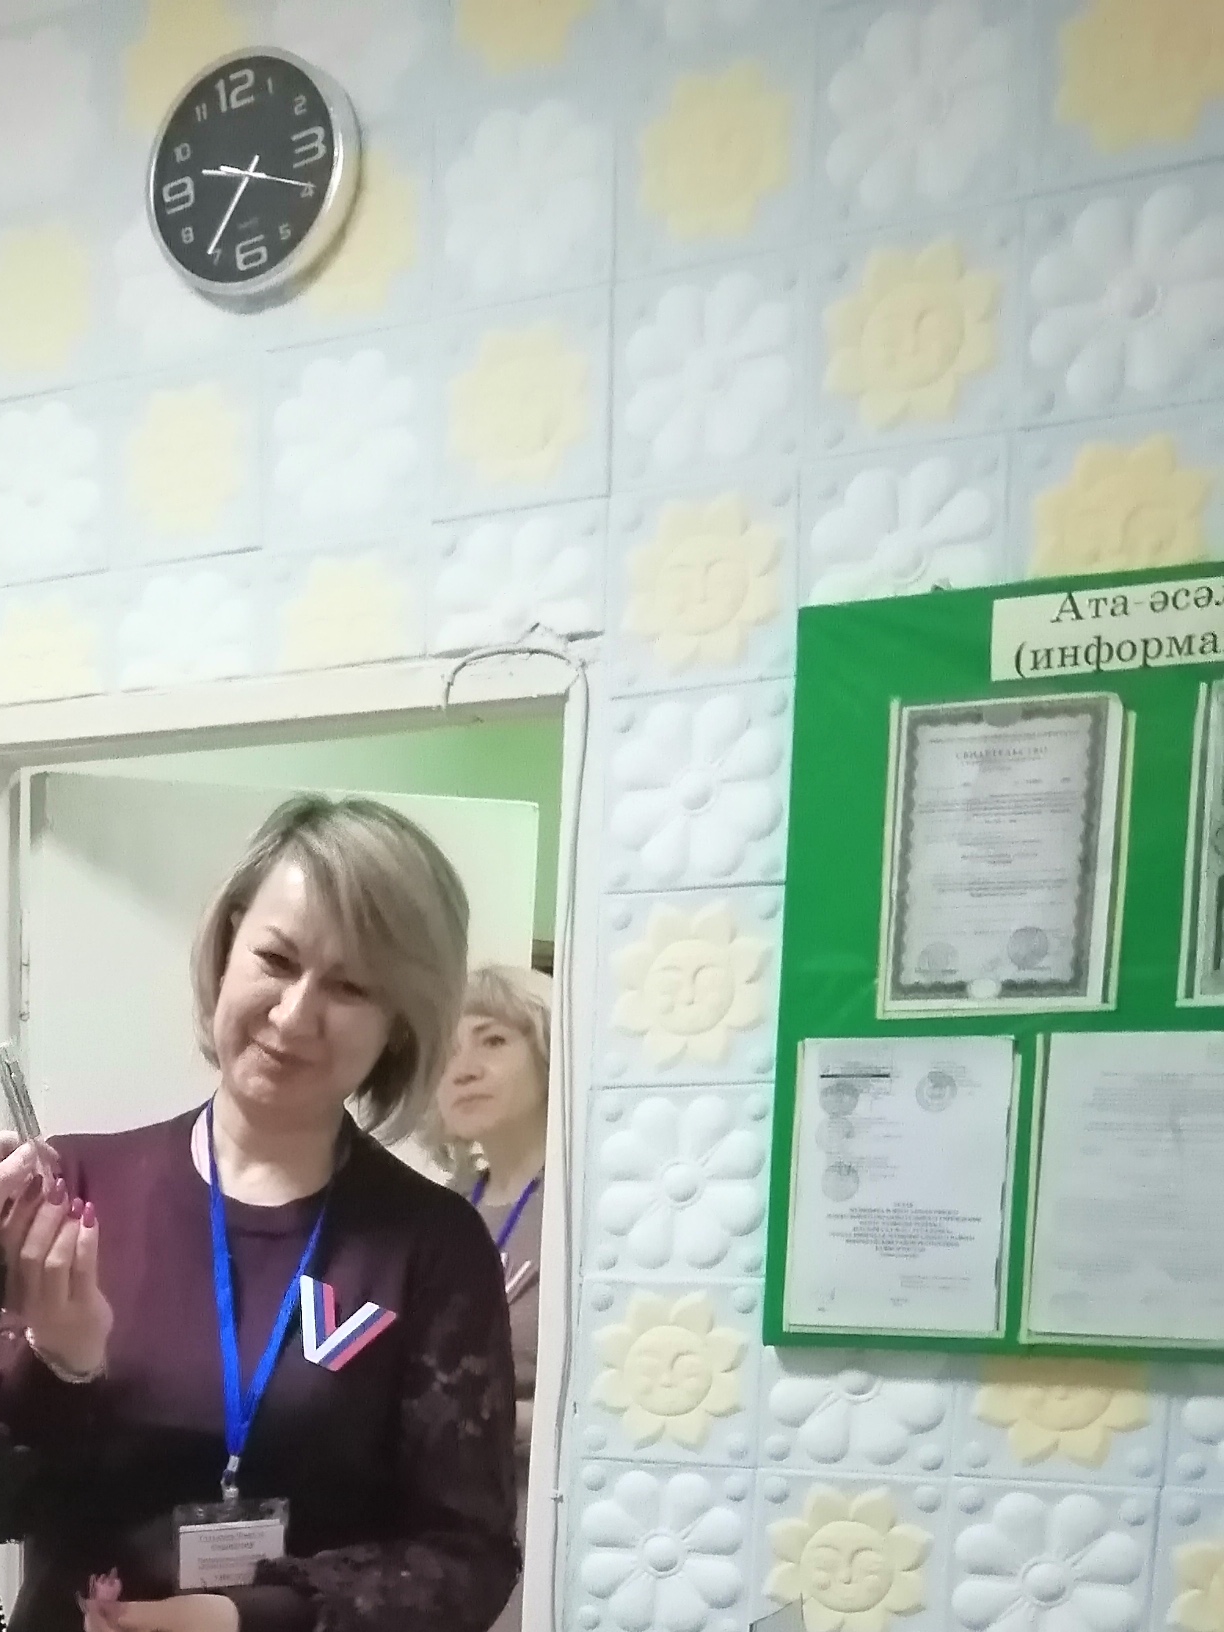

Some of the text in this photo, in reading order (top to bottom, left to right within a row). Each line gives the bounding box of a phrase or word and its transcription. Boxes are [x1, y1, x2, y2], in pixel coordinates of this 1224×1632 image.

[215, 68, 256, 113] 12
[267, 77, 273, 94] 1
[195, 103, 208, 122] 11
[293, 94, 308, 115] 2
[175, 142, 192, 163] 10
[291, 125, 326, 169] 3
[162, 176, 195, 215] 9
[181, 226, 194, 244] 8
[279, 222, 292, 240] 5
[235, 234, 269, 271] 6
